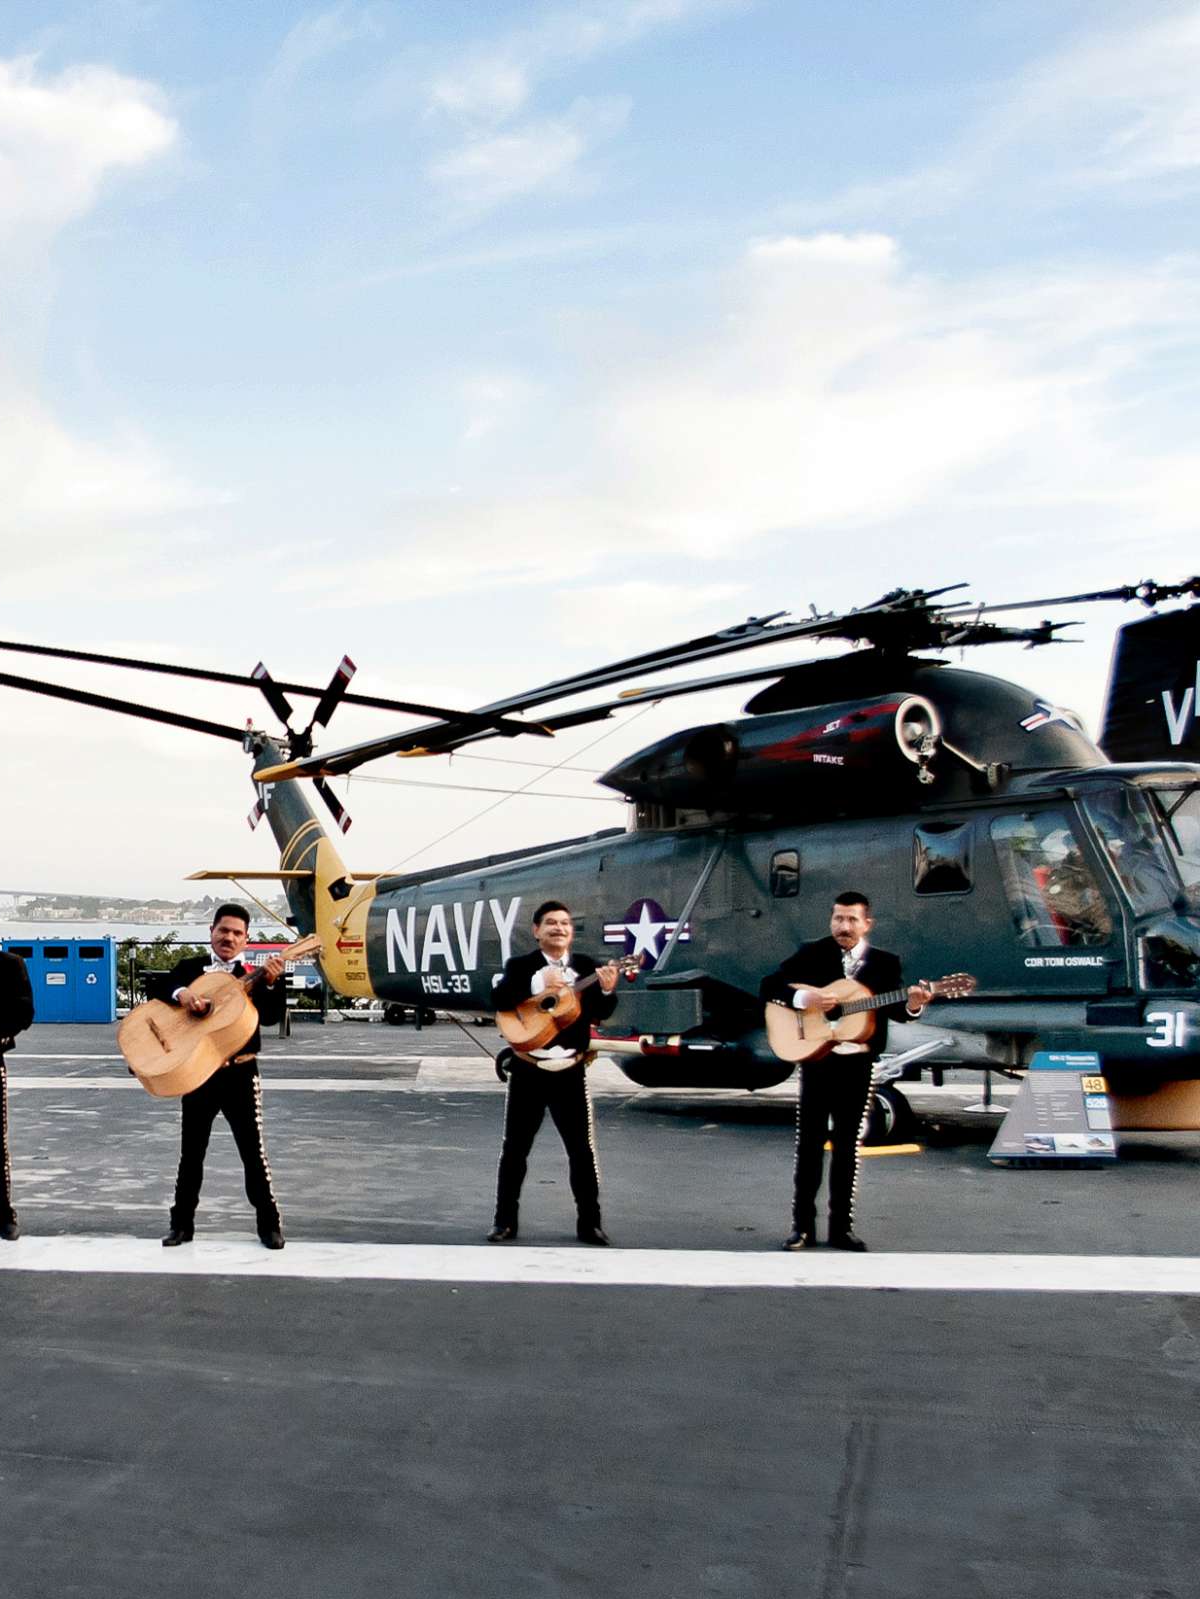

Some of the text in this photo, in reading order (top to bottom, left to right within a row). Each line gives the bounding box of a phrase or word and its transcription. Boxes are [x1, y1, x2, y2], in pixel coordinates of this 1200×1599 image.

[813, 753, 845, 766] INTAKE
[386, 896, 522, 973] NAVY
[1024, 957, 1044, 968] CDR
[1044, 957, 1065, 967] TOM
[421, 974, 471, 994] HSL-33
[1146, 1011, 1184, 1047] 31
[1085, 1078, 1103, 1091] 48
